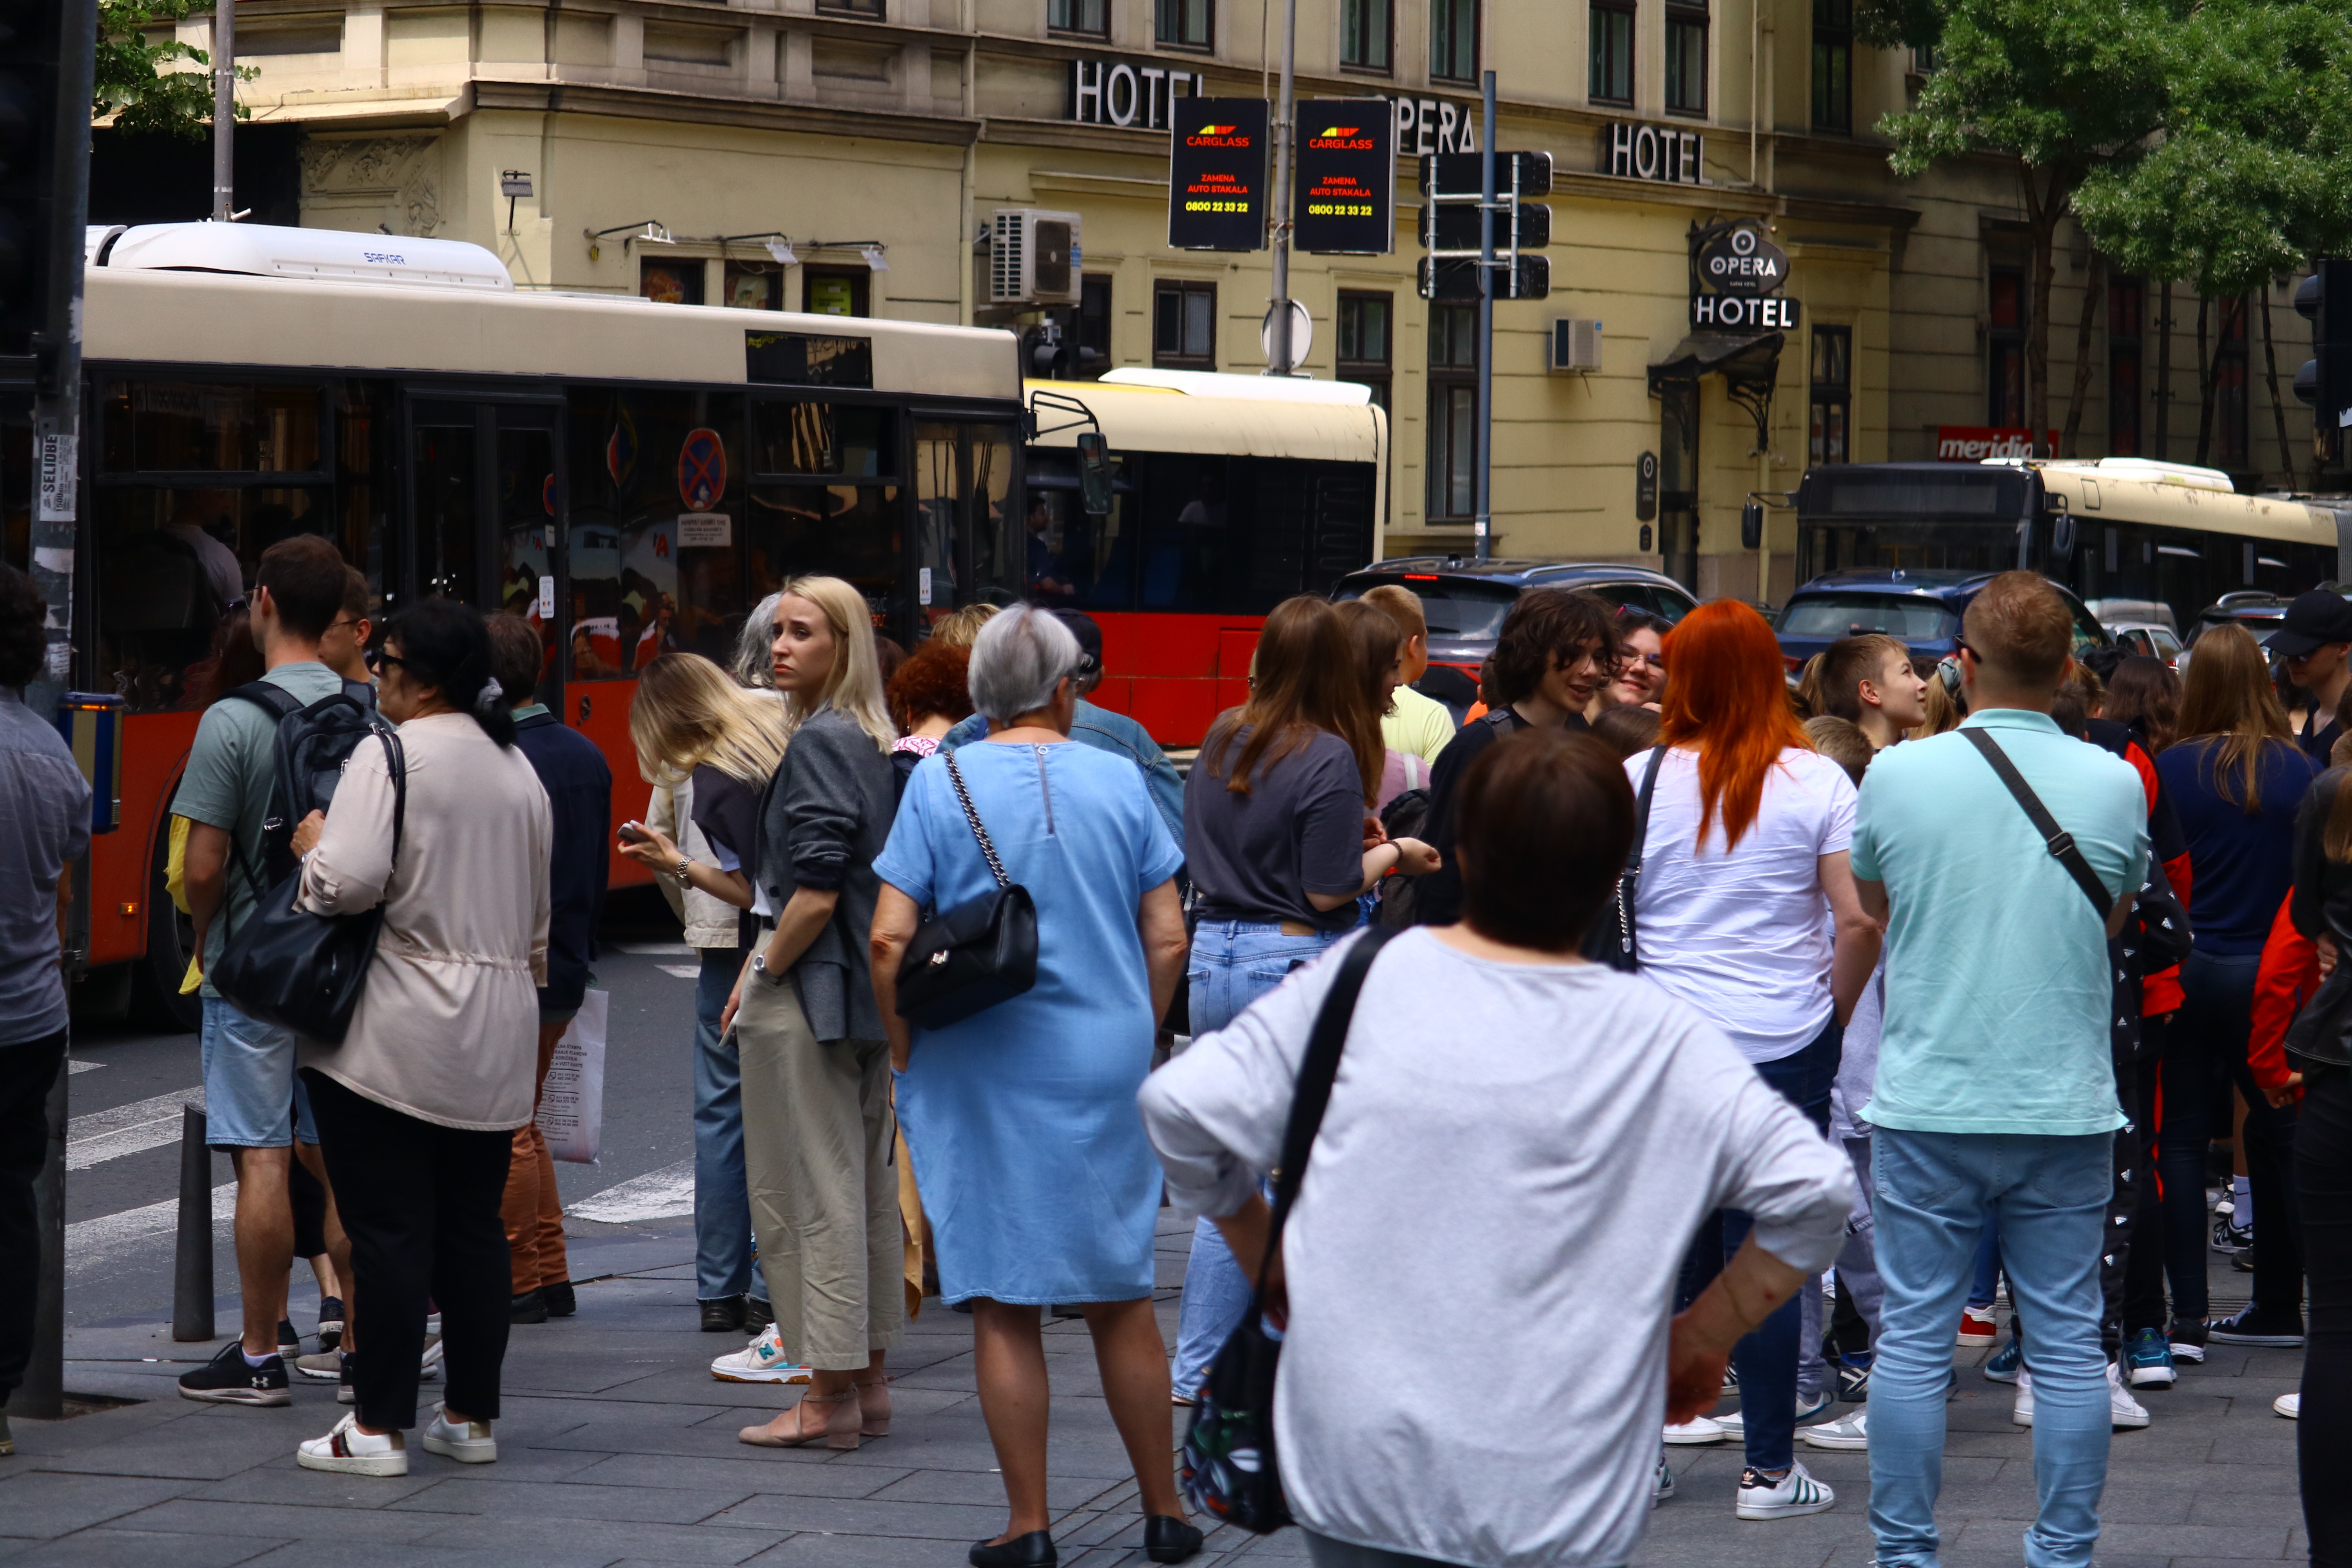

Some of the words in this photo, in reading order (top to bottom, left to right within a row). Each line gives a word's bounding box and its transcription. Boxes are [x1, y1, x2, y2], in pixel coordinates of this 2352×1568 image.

[1376, 94, 1475, 154] PERA
[1187, 136, 1250, 147] CARGLASS
[1309, 139, 1373, 149] CARGLASS
[1612, 123, 1713, 186] HOTEL
[1332, 188, 1371, 197] STAKALA
[1185, 201, 1211, 211] 0800
[1212, 202, 1223, 212] 22
[1224, 202, 1236, 212] 33
[1237, 203, 1249, 212] 22
[1308, 205, 1333, 214] 0800
[1334, 205, 1346, 215] 22
[1347, 205, 1359, 216] 33
[1360, 206, 1372, 216] 22
[363, 252, 406, 265] SAFKAR
[1710, 256, 1777, 276] OPERA
[1697, 296, 1792, 327] HOTEL
[1939, 434, 2054, 459] meridia
[43, 436, 57, 493] SELIDBE
